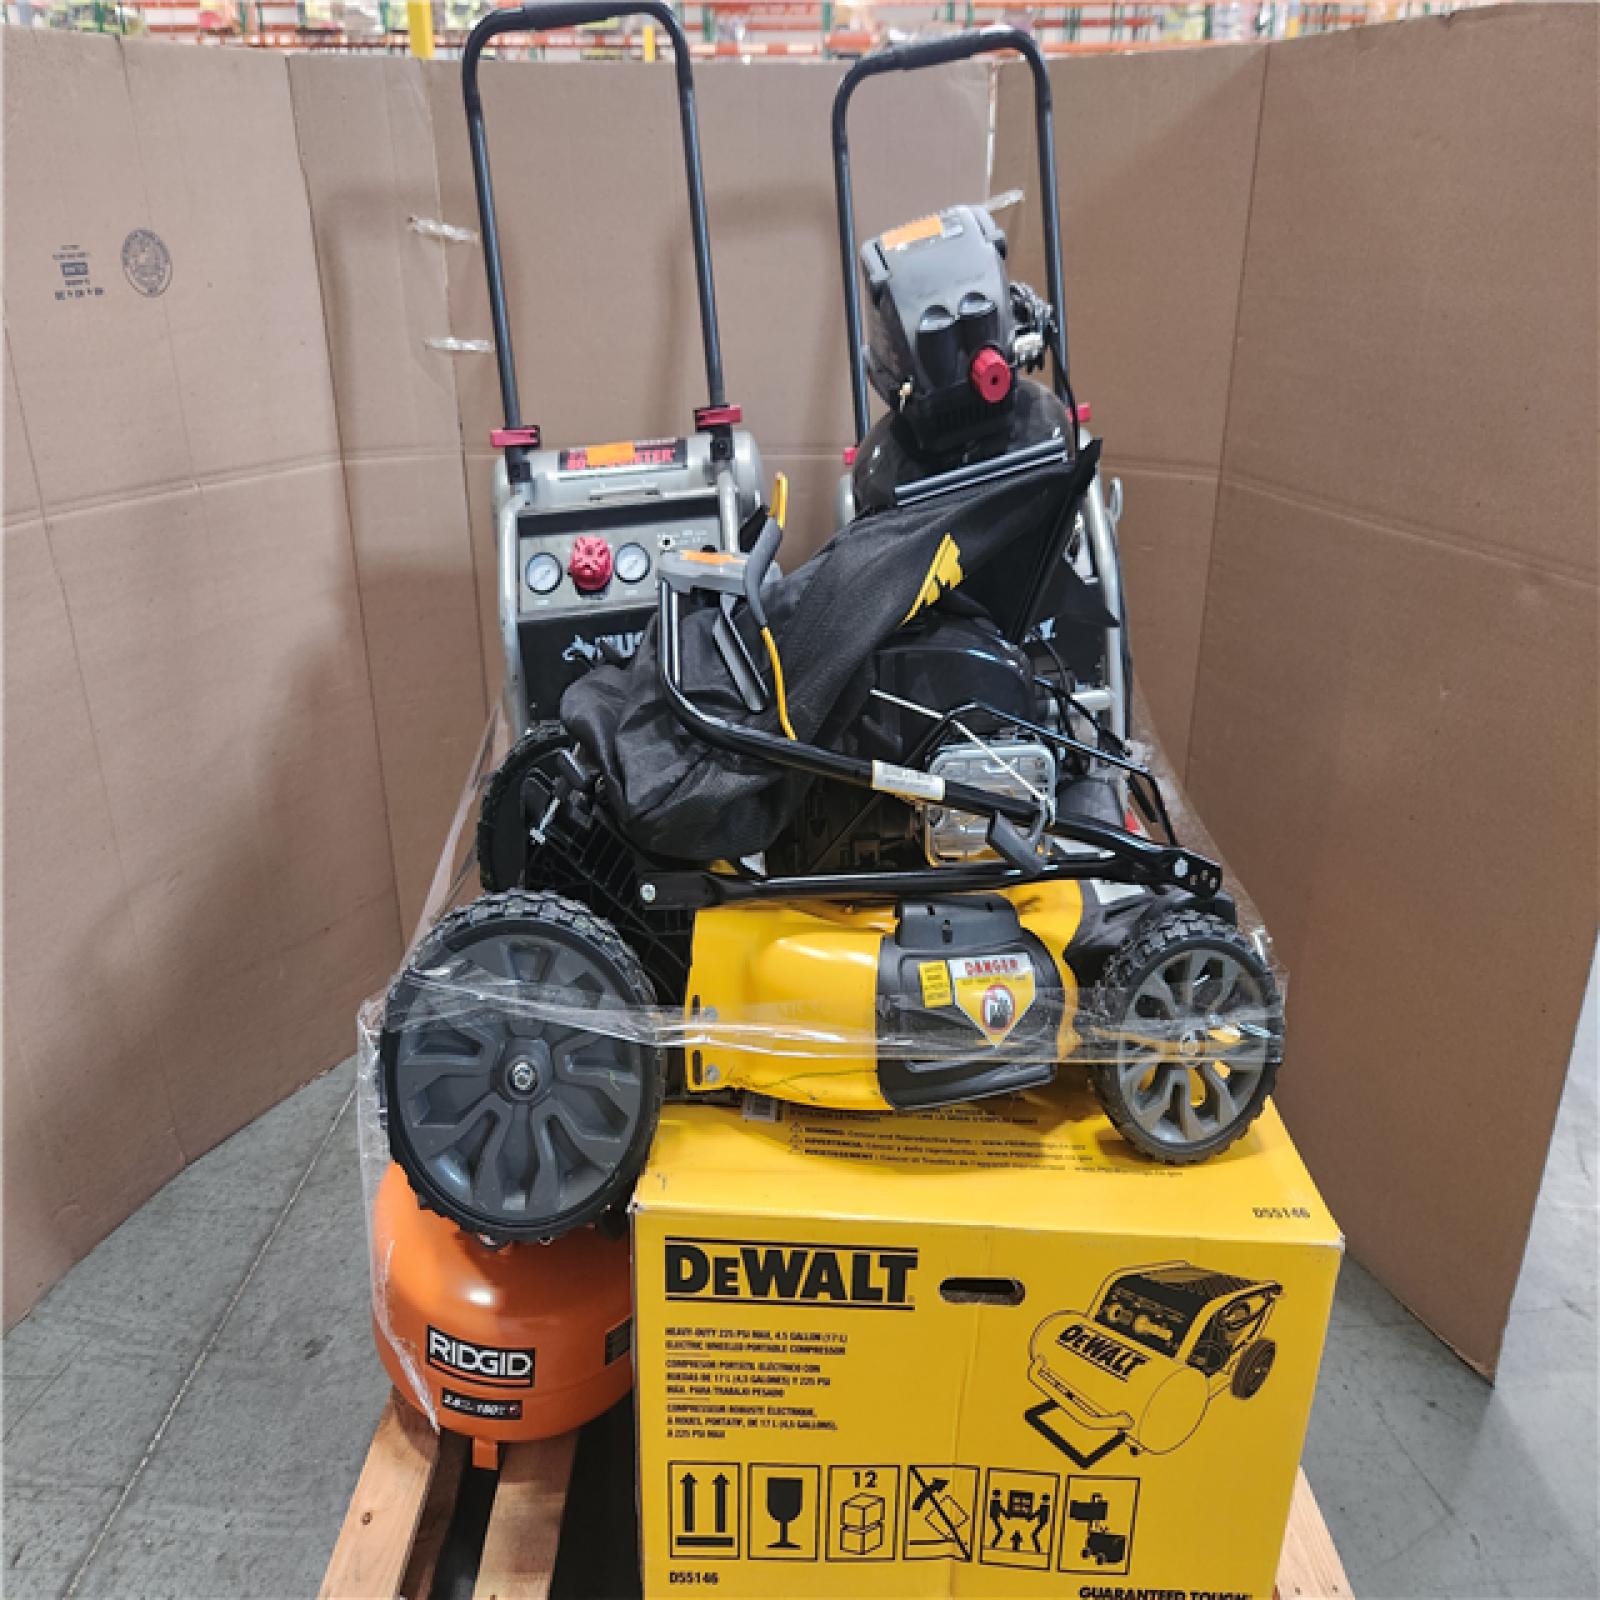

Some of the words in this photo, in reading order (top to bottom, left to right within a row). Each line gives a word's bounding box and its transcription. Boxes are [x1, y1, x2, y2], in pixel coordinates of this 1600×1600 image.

[964, 959, 1018, 976] DANGER
[429, 1330, 533, 1376] RIDGID
[852, 1470, 878, 1488] 12
[669, 1571, 719, 1585] D55146
